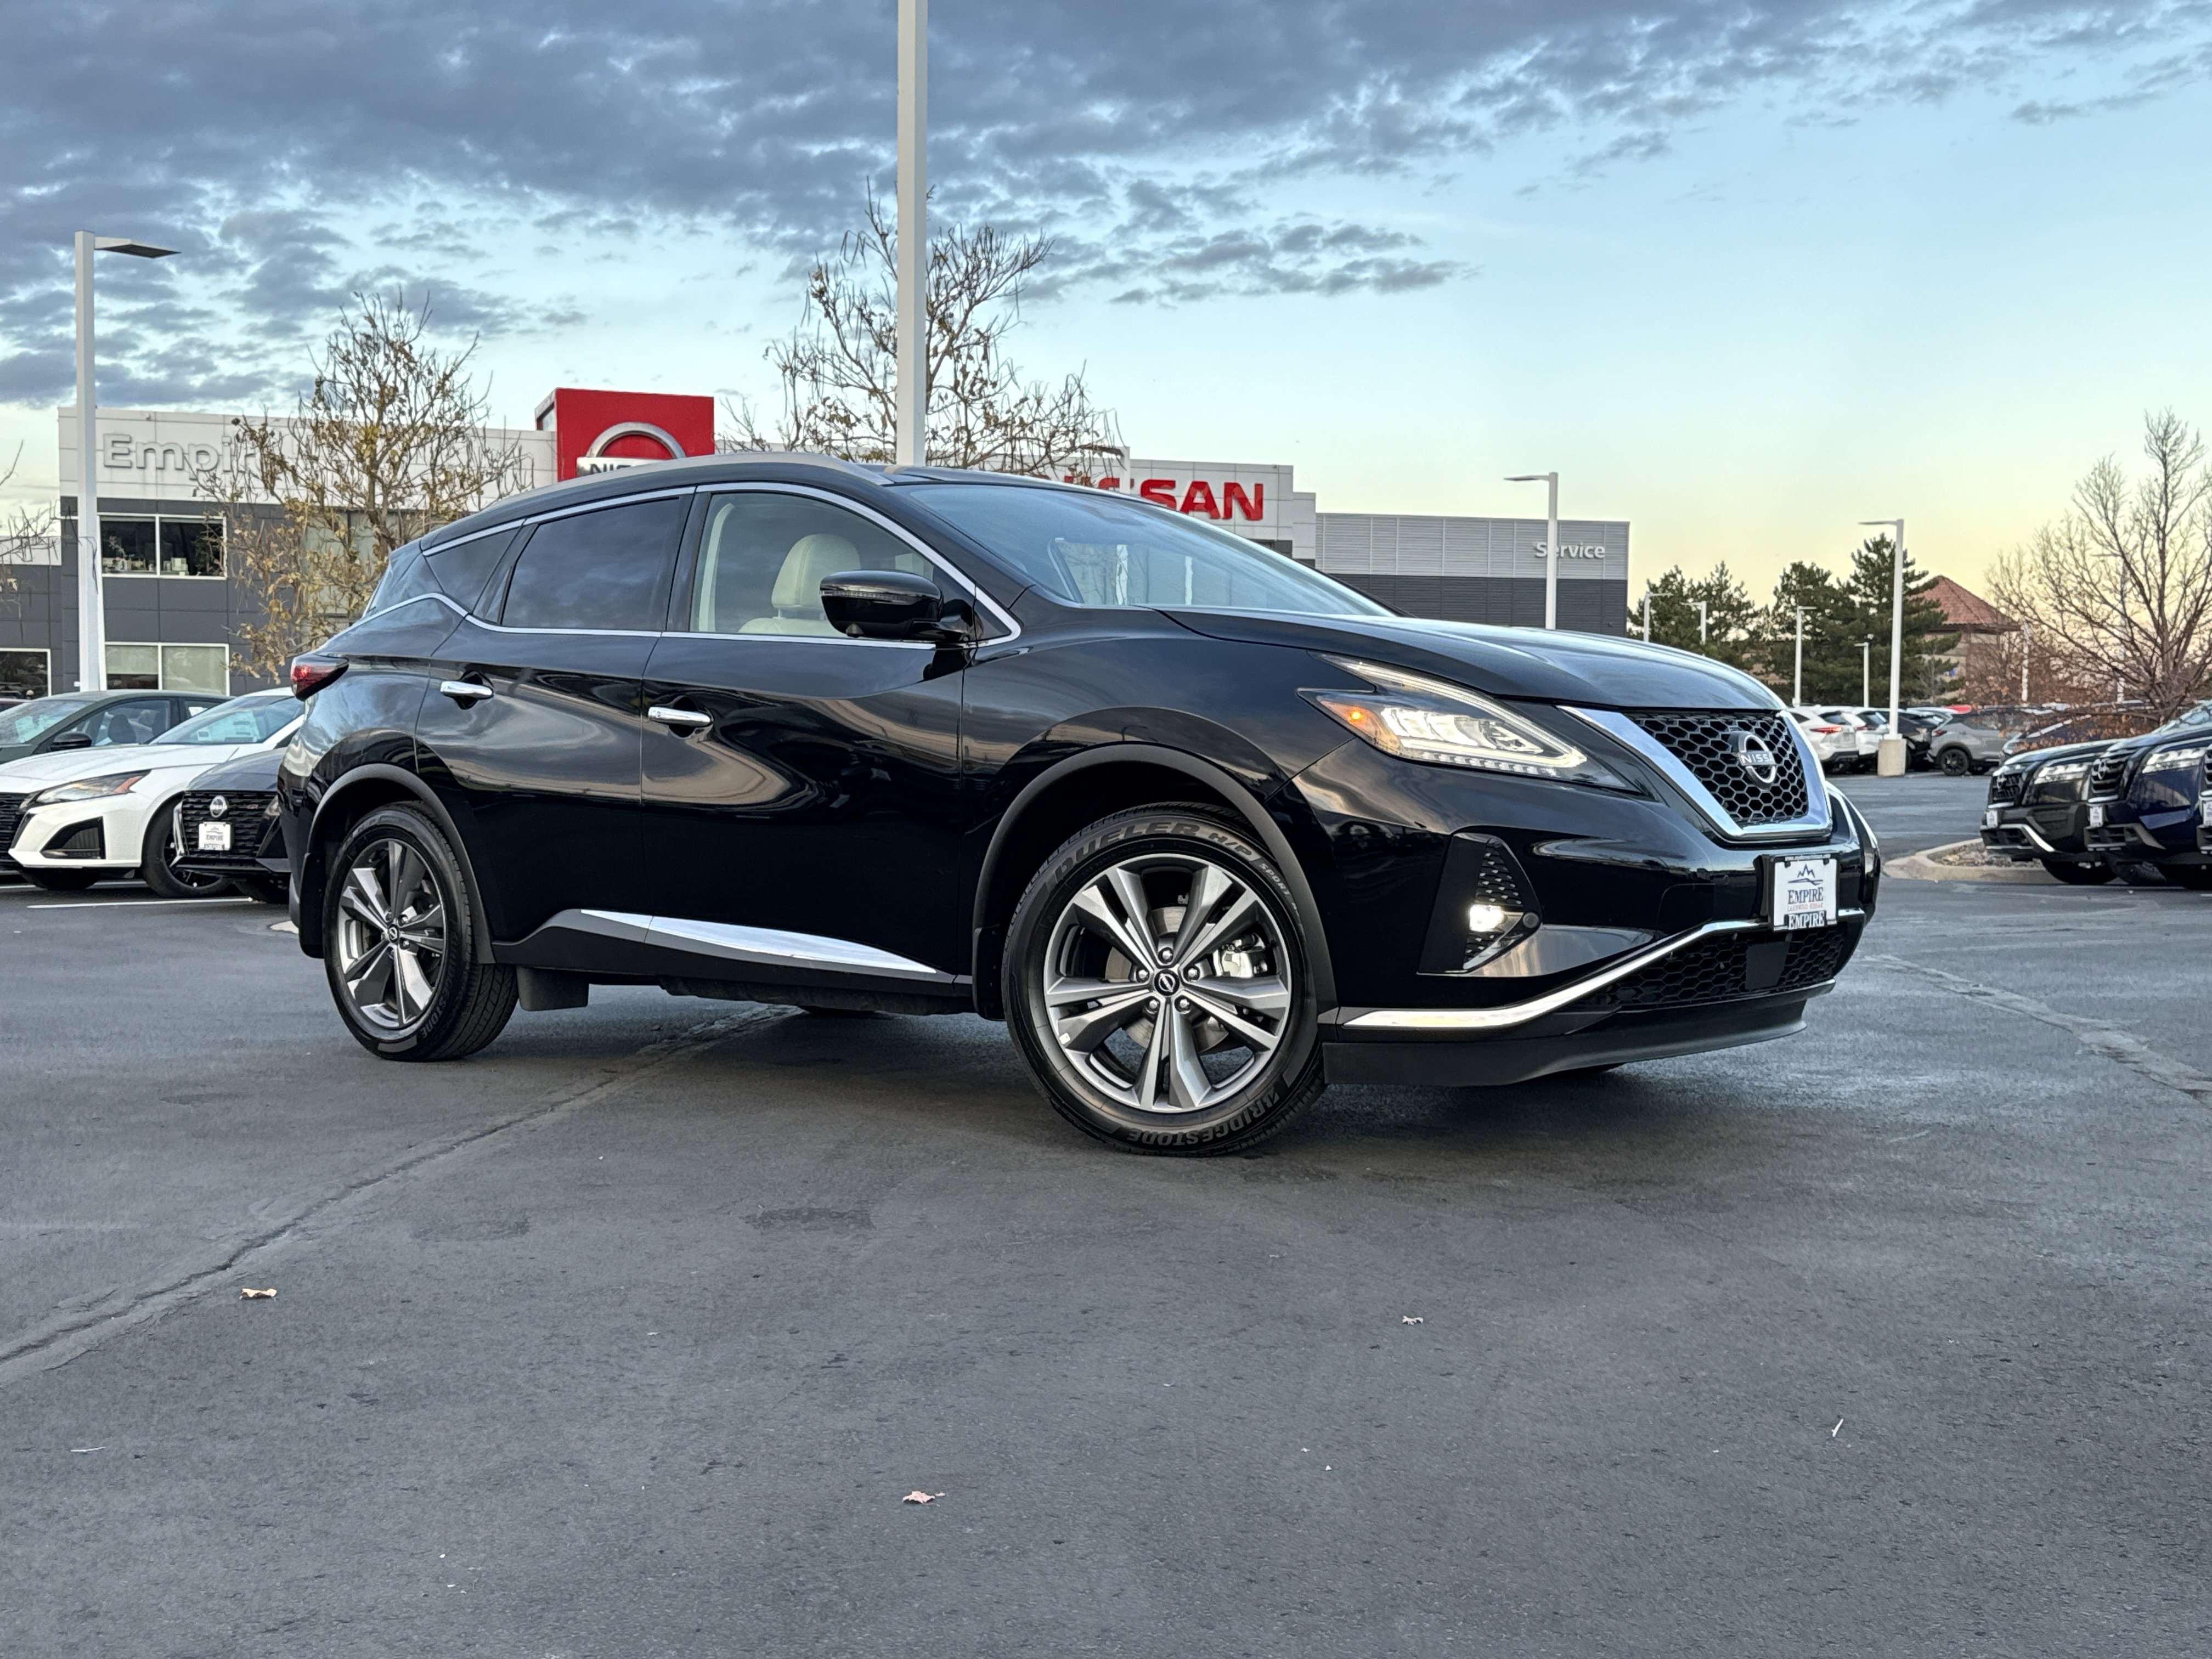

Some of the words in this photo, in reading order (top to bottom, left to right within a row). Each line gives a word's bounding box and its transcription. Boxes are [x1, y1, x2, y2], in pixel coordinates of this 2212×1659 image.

[103, 433, 280, 481] Empir
[1535, 541, 1605, 558] Srvice
[1054, 821, 1200, 882] DUELER
[1208, 832, 1252, 856] H/P
[1787, 887, 1824, 905] EMPIRE
[1788, 911, 1825, 930] EMPIRE
[1127, 1086, 1280, 1146] BRIDGESTONE
